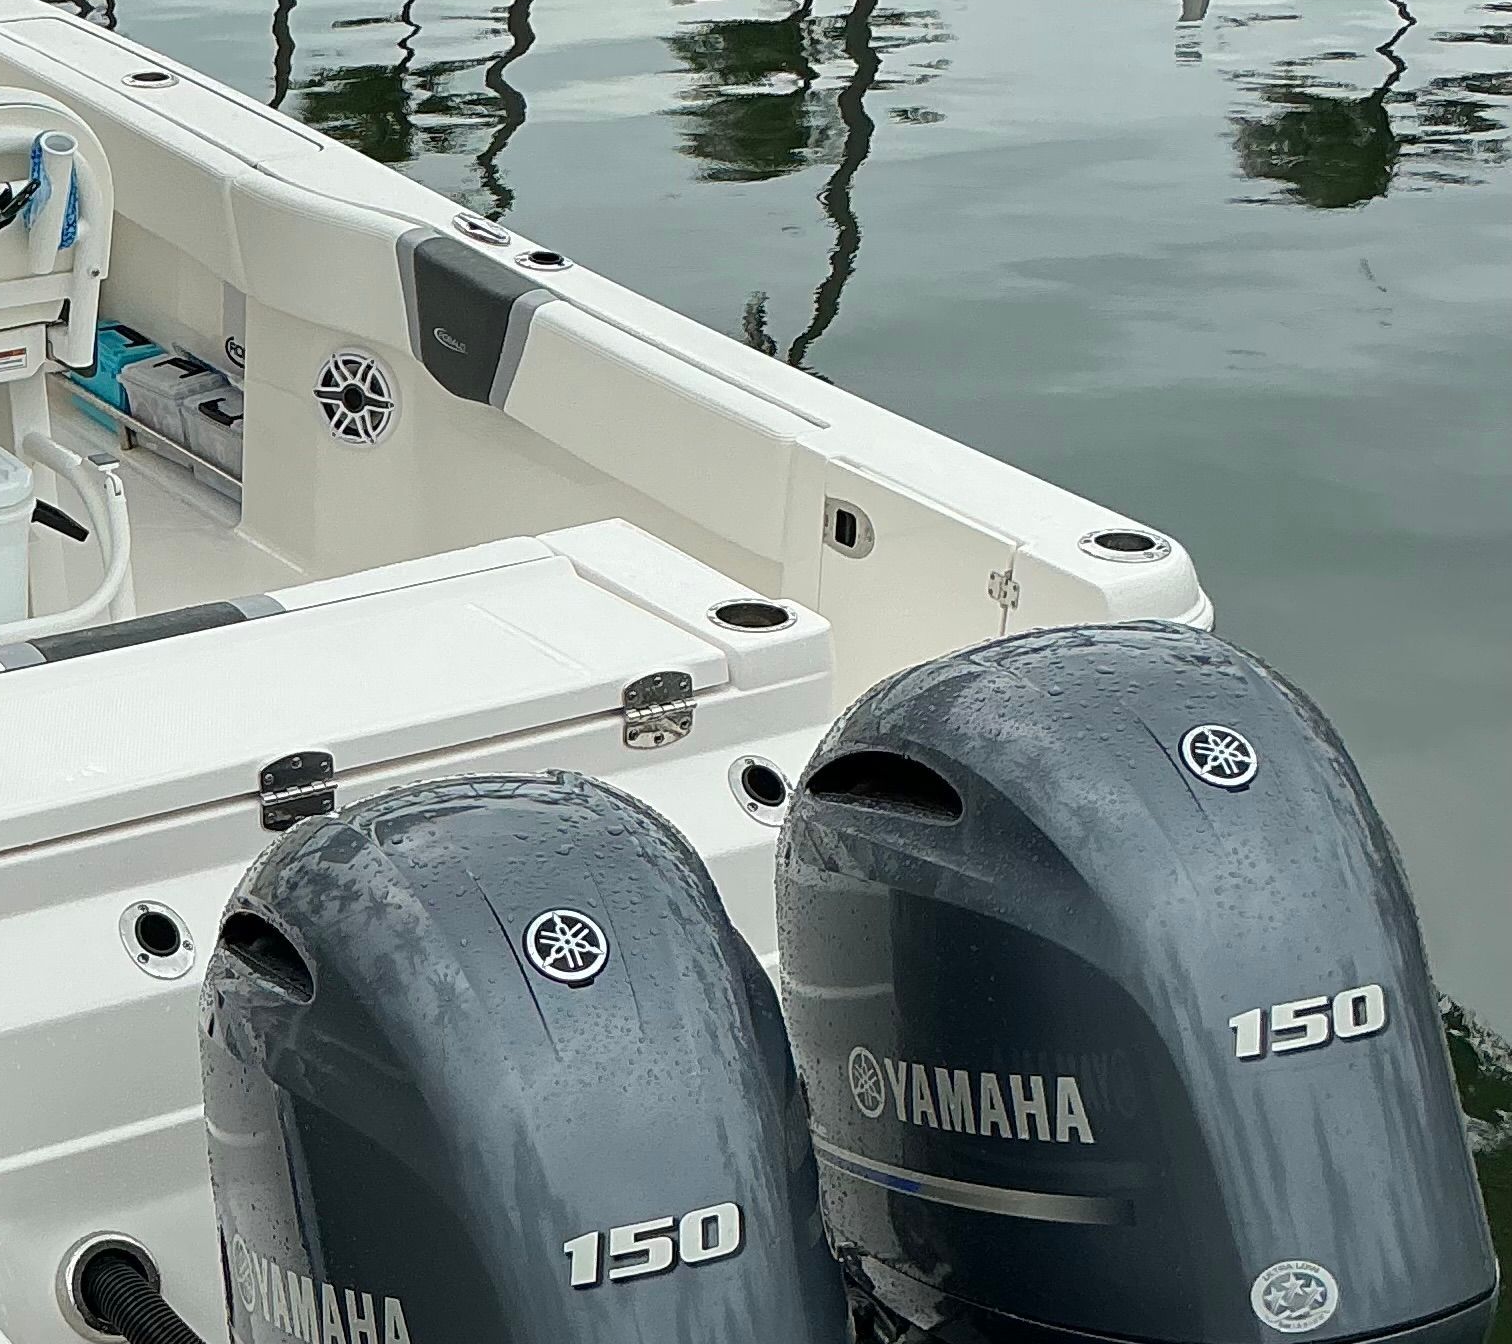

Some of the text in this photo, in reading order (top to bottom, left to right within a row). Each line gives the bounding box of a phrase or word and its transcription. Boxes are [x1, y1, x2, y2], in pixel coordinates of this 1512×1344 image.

[1228, 983, 1386, 1058] 150
[884, 1057, 1095, 1144] YAMAHA
[563, 1200, 741, 1288] 150
